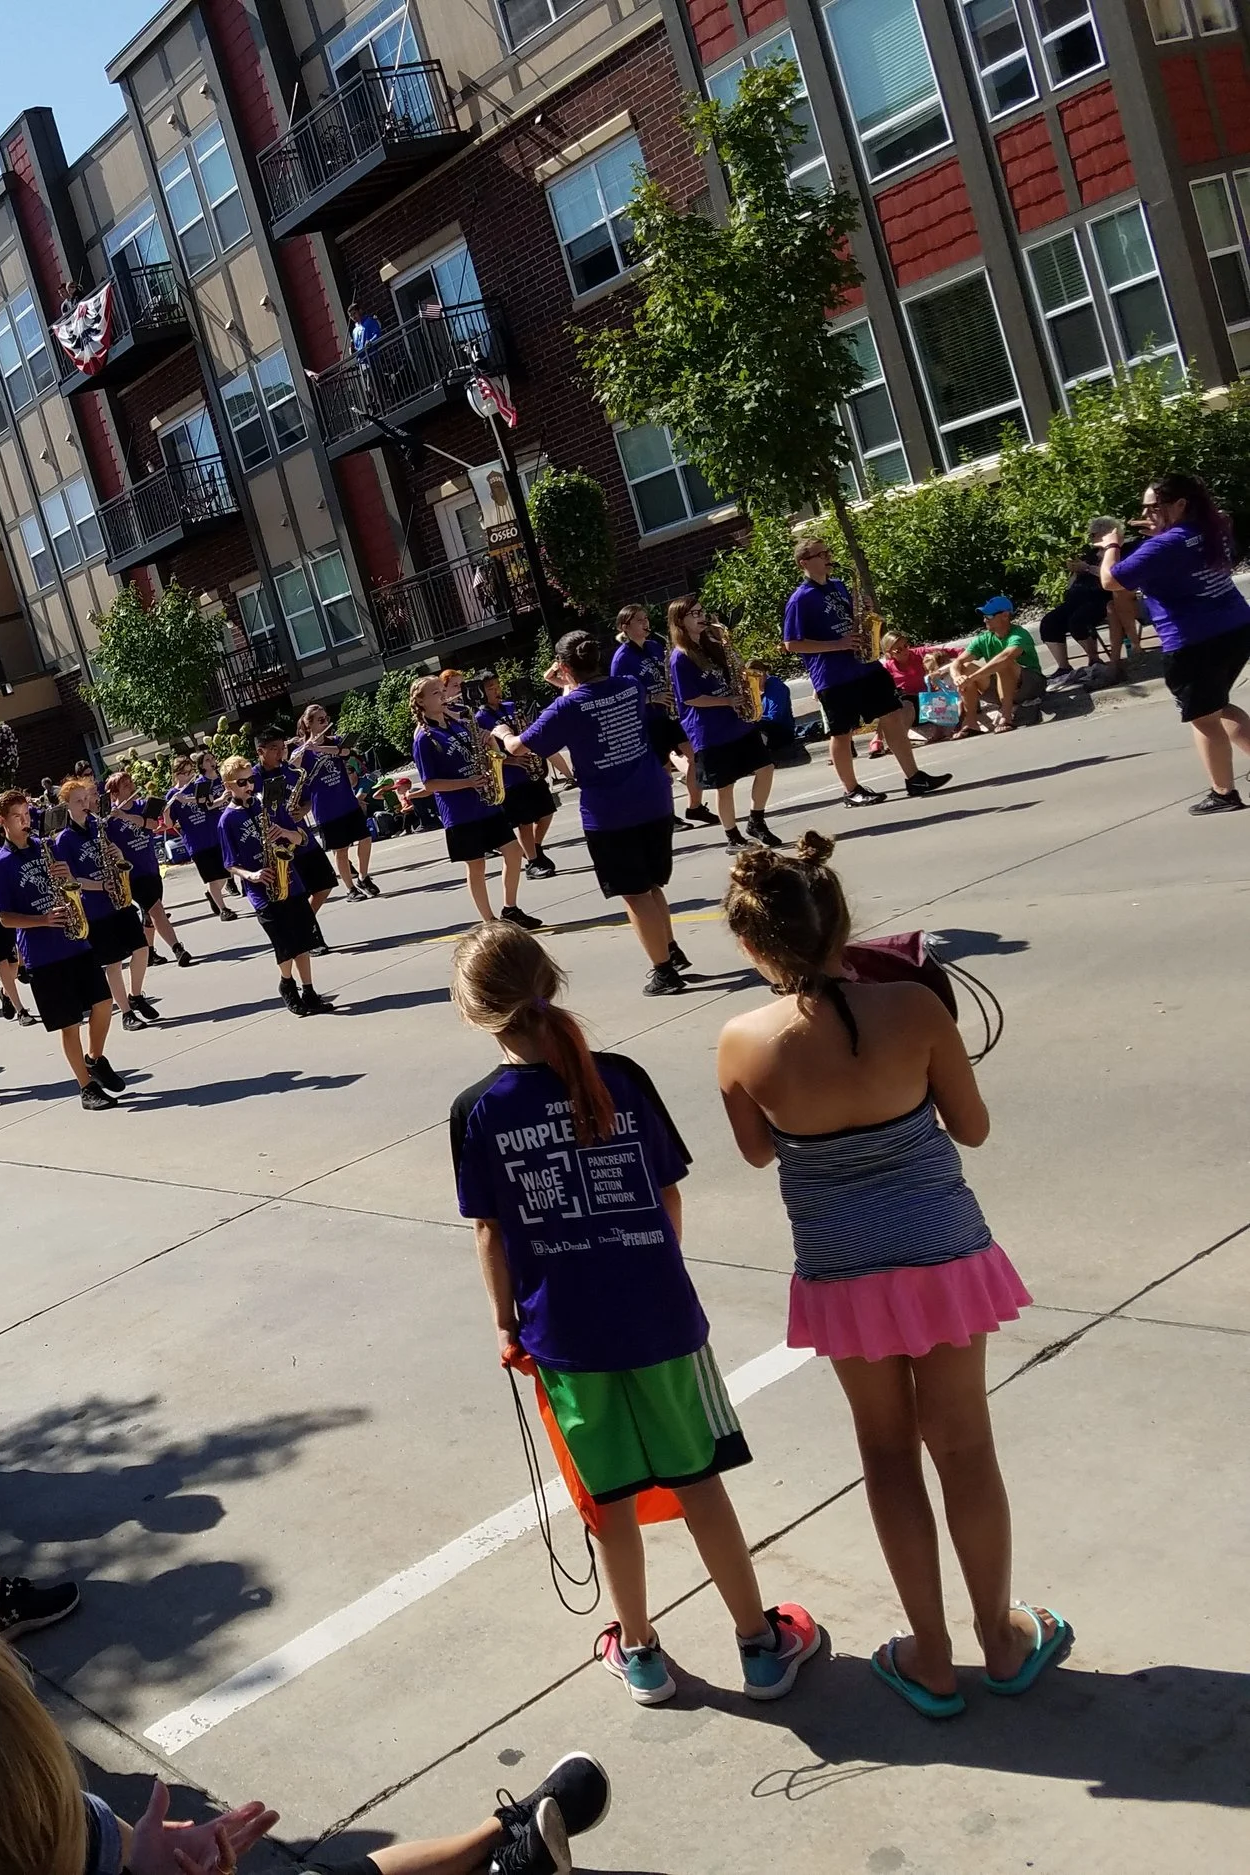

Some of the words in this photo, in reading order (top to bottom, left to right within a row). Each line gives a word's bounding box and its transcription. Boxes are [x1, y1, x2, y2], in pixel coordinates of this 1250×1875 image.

[490, 526, 518, 543] OSSEO
[580, 700, 595, 711] 2016
[21, 858, 46, 872] UNITED
[587, 1152, 636, 1167] PANCREATIC
[518, 1166, 563, 1191] WAGE
[590, 1167, 623, 1179] CANCER
[594, 1180, 623, 1192] ACTION
[526, 1186, 568, 1210] HOPE
[596, 1192, 636, 1204] NETWORK
[611, 1227, 625, 1235] The
[622, 1229, 664, 1246] SPECIALISTS
[562, 1239, 591, 1251] Dental
